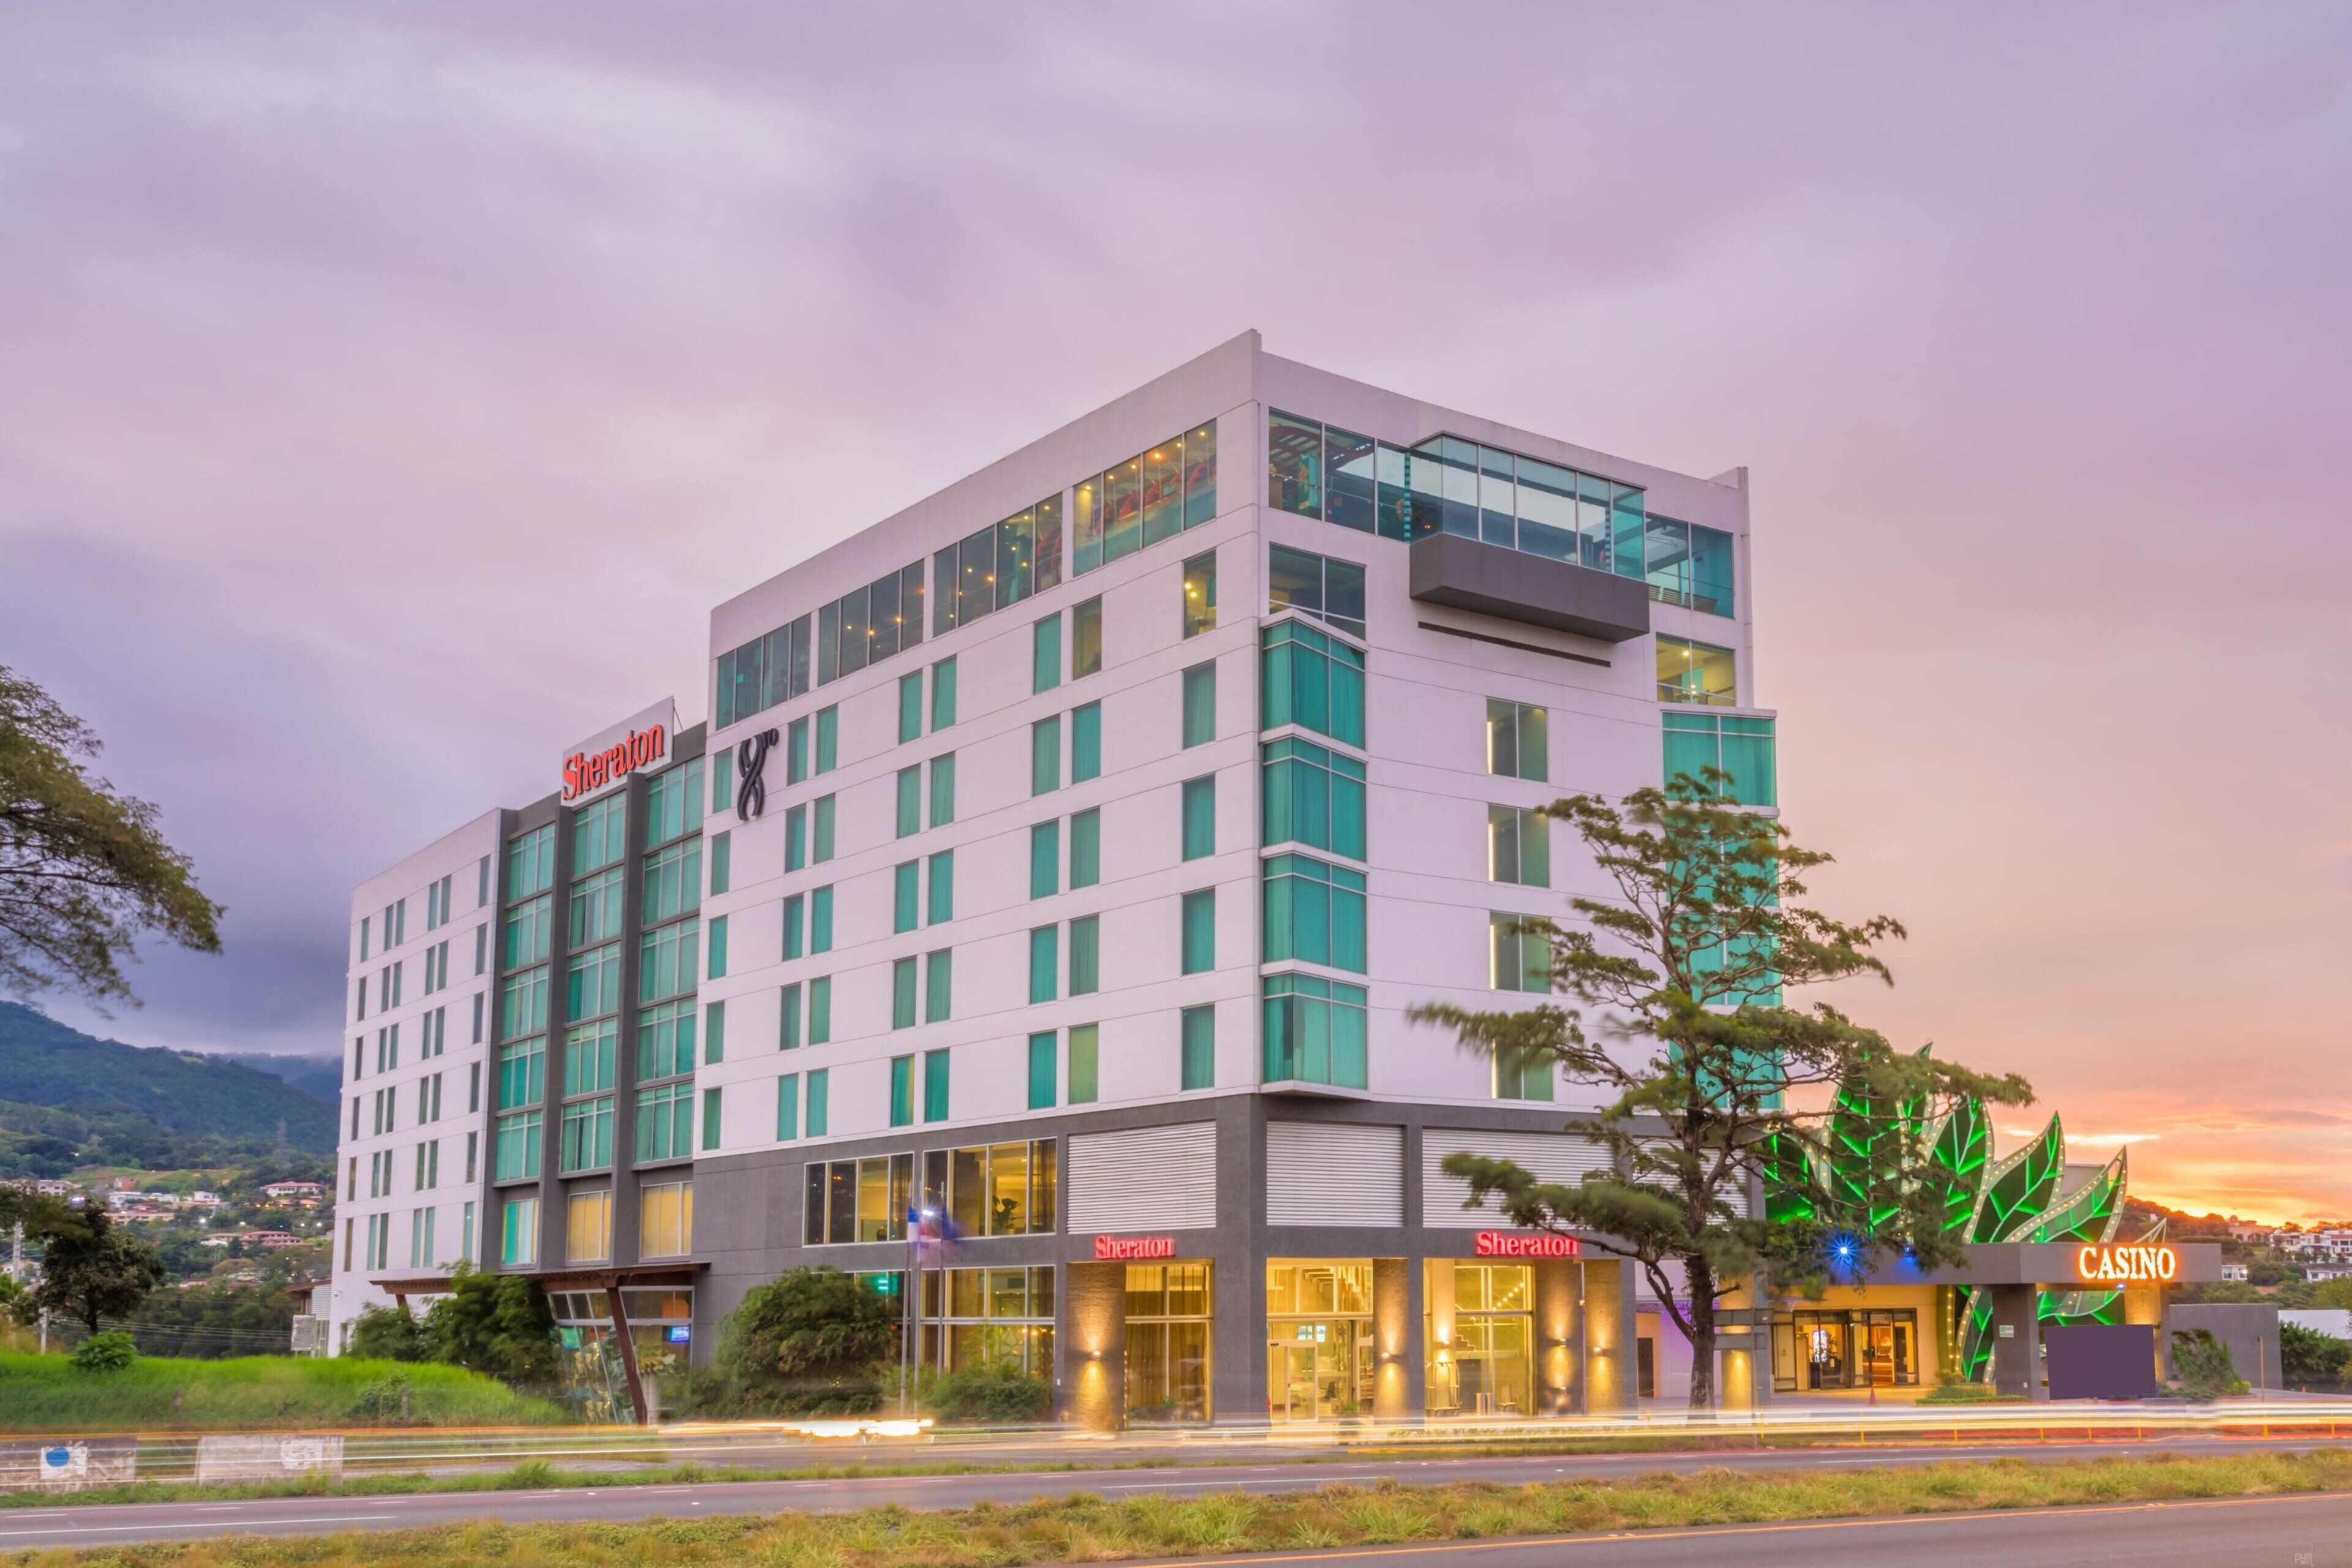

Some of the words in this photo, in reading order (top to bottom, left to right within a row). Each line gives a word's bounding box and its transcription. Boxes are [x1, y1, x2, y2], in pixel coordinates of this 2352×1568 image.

[564, 724, 663, 800] Sheraton
[1095, 1235, 1175, 1259] Sheraton
[1476, 1231, 1579, 1256] Sheraton
[2079, 1246, 2176, 1280] CASINO
